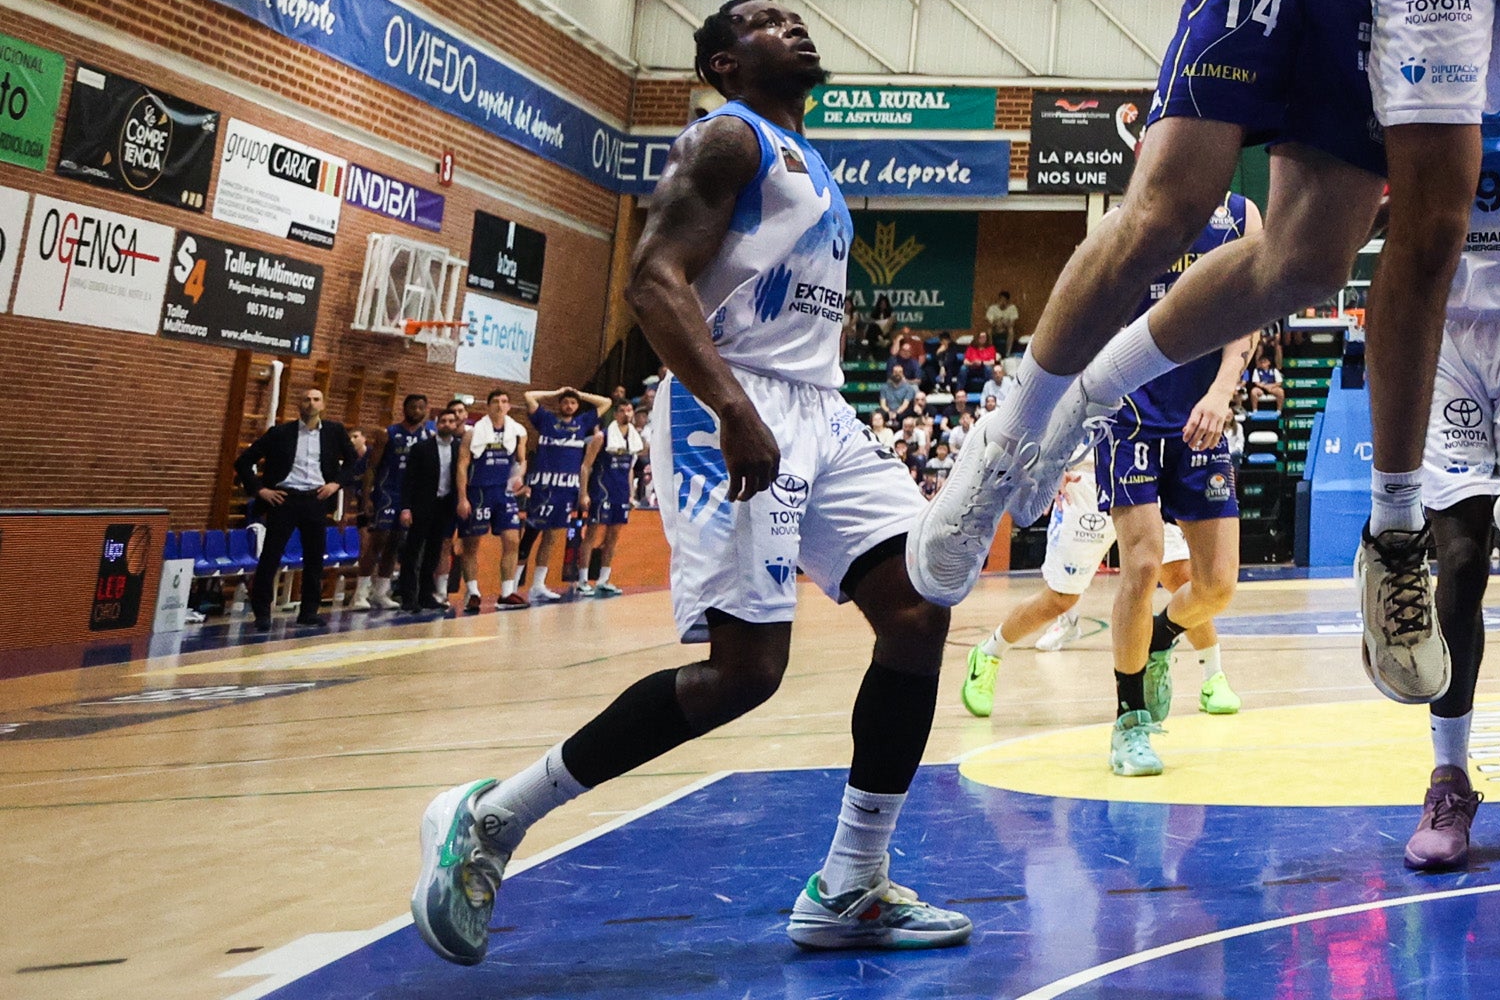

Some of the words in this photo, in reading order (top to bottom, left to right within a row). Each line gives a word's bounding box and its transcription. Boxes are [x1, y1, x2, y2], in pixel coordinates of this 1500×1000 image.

[1405, 12, 1473, 25] NOVOMOTOR
[384, 15, 477, 103] OVIEDO
[477, 88, 514, 128] capital
[514, 100, 531, 135] del
[531, 109, 566, 149] deporte
[1181, 63, 1257, 83] ALIMERKA
[1432, 75, 1443, 83] DE
[823, 90, 874, 109] CAJA
[879, 91, 950, 109] RURAL
[824, 111, 843, 123] DE
[845, 112, 912, 124] ASTURIAS
[126, 118, 169, 151] COMPE
[123, 142, 161, 172] TENCIA
[225, 131, 268, 169] grupo
[272, 147, 318, 185] CARAC
[443, 154, 452, 181] 3
[592, 128, 672, 182] OVIED
[1039, 151, 1059, 164] LA
[1065, 149, 1123, 164] PASIÓN
[832, 158, 871, 185] del
[877, 157, 971, 189] deporte
[1038, 172, 1070, 184] NOS
[1075, 172, 1107, 184] UNE
[346, 165, 418, 222] INDIBA
[40, 208, 159, 277] OGENSA
[173, 236, 208, 305] S4
[225, 248, 257, 277] Taller
[256, 257, 316, 290] Multimarca
[167, 303, 189, 319] Taller
[789, 302, 821, 317] NEW
[482, 314, 533, 362] Enerthy
[1443, 429, 1488, 442] TOYOTA
[1134, 441, 1149, 471] 0
[540, 505, 554, 517] 17
